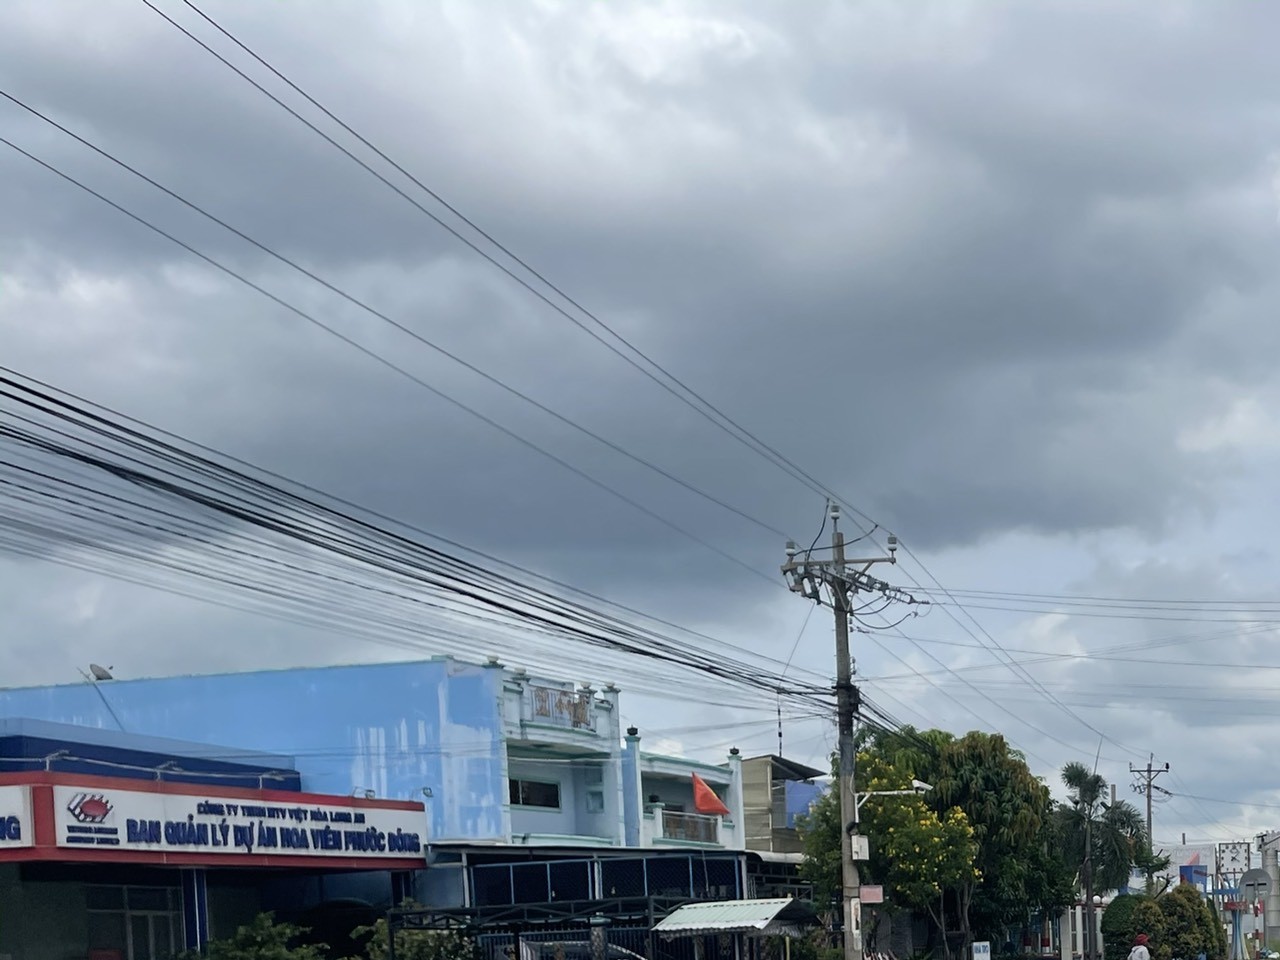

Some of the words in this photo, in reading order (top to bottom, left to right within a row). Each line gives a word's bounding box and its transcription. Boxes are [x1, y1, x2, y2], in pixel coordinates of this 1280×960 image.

[226, 804, 238, 816] TY
[126, 818, 162, 844] BAN
[164, 813, 209, 846] QUẢN
[210, 818, 230, 847] LÝ
[233, 821, 255, 854] DỰ
[257, 820, 278, 848] ÁN
[280, 826, 310, 849] HOA
[310, 824, 343, 850] VIÊN
[343, 826, 386, 852] PHƯỚC
[387, 827, 421, 853] ĐÔNG
